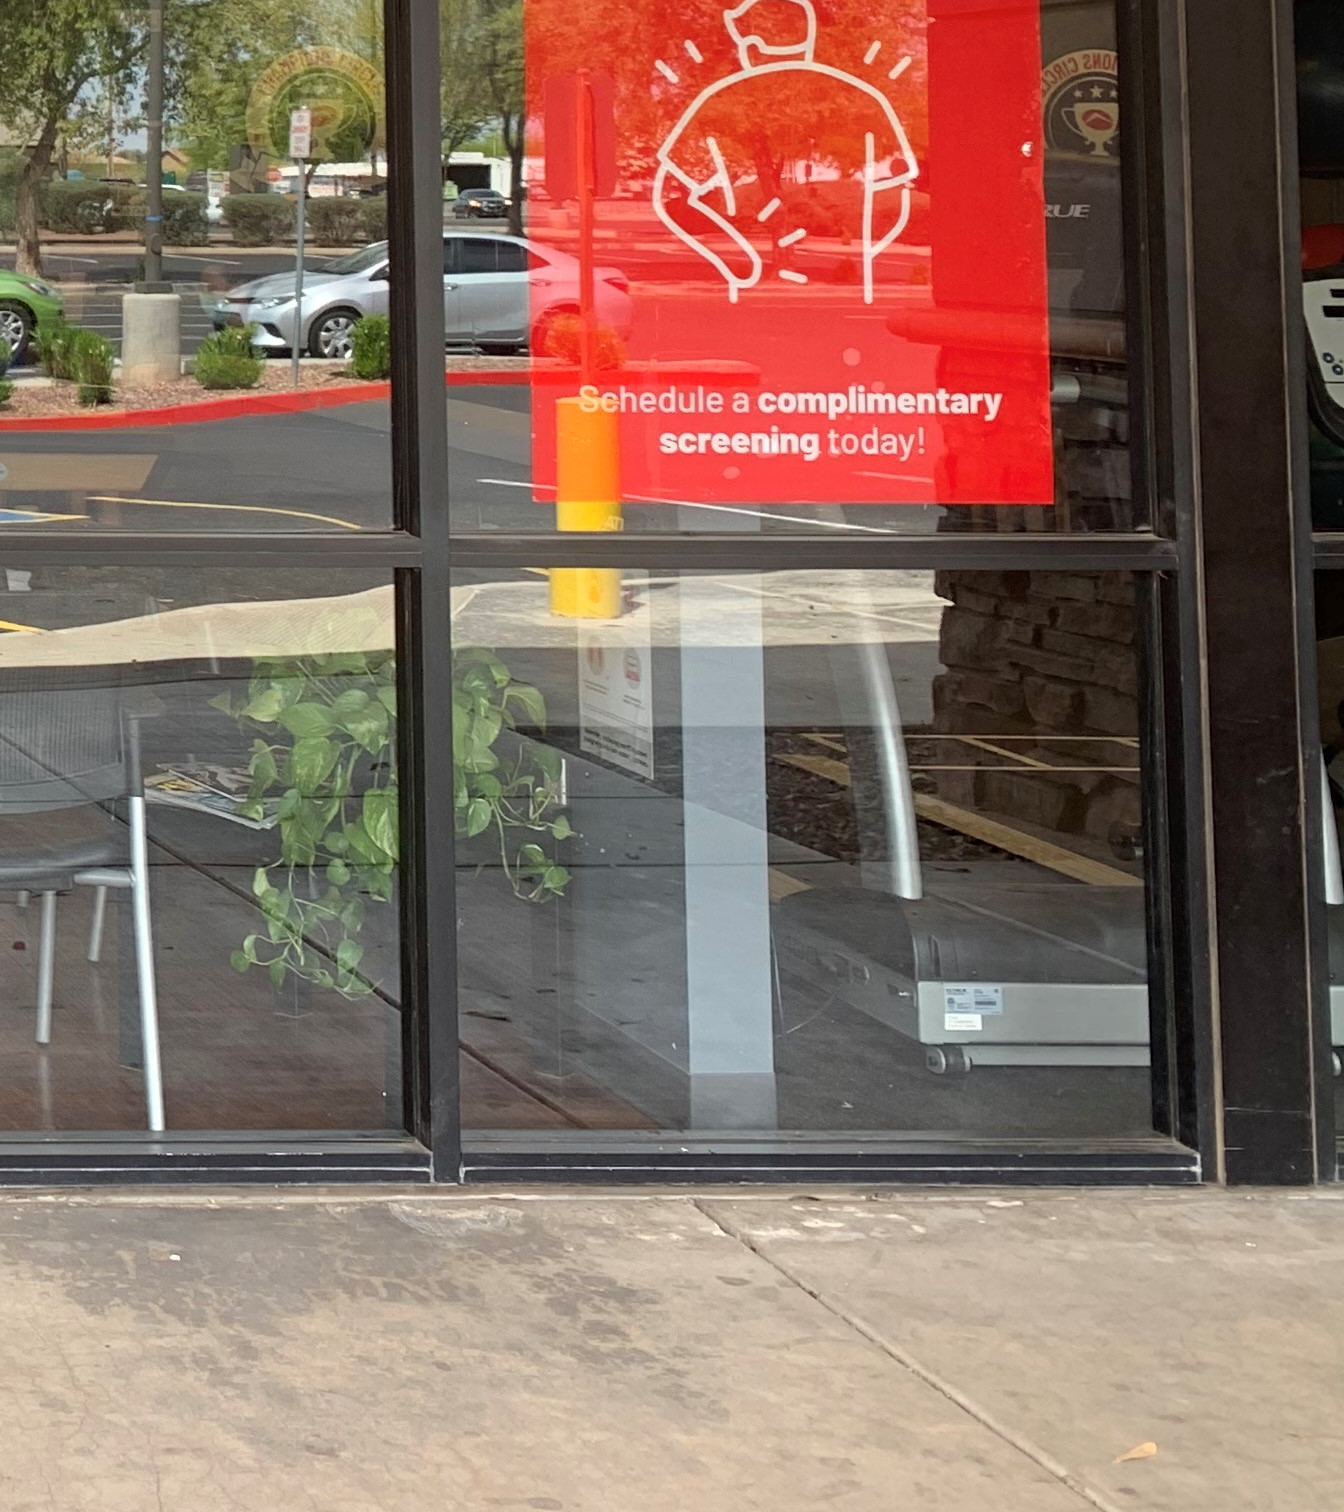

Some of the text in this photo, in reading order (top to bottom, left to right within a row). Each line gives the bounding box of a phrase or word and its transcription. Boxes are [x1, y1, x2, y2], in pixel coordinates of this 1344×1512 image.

[1044, 204, 1091, 219] RUE
[578, 385, 1004, 423] Schedule a complimentary
[659, 426, 926, 463] screening today!
